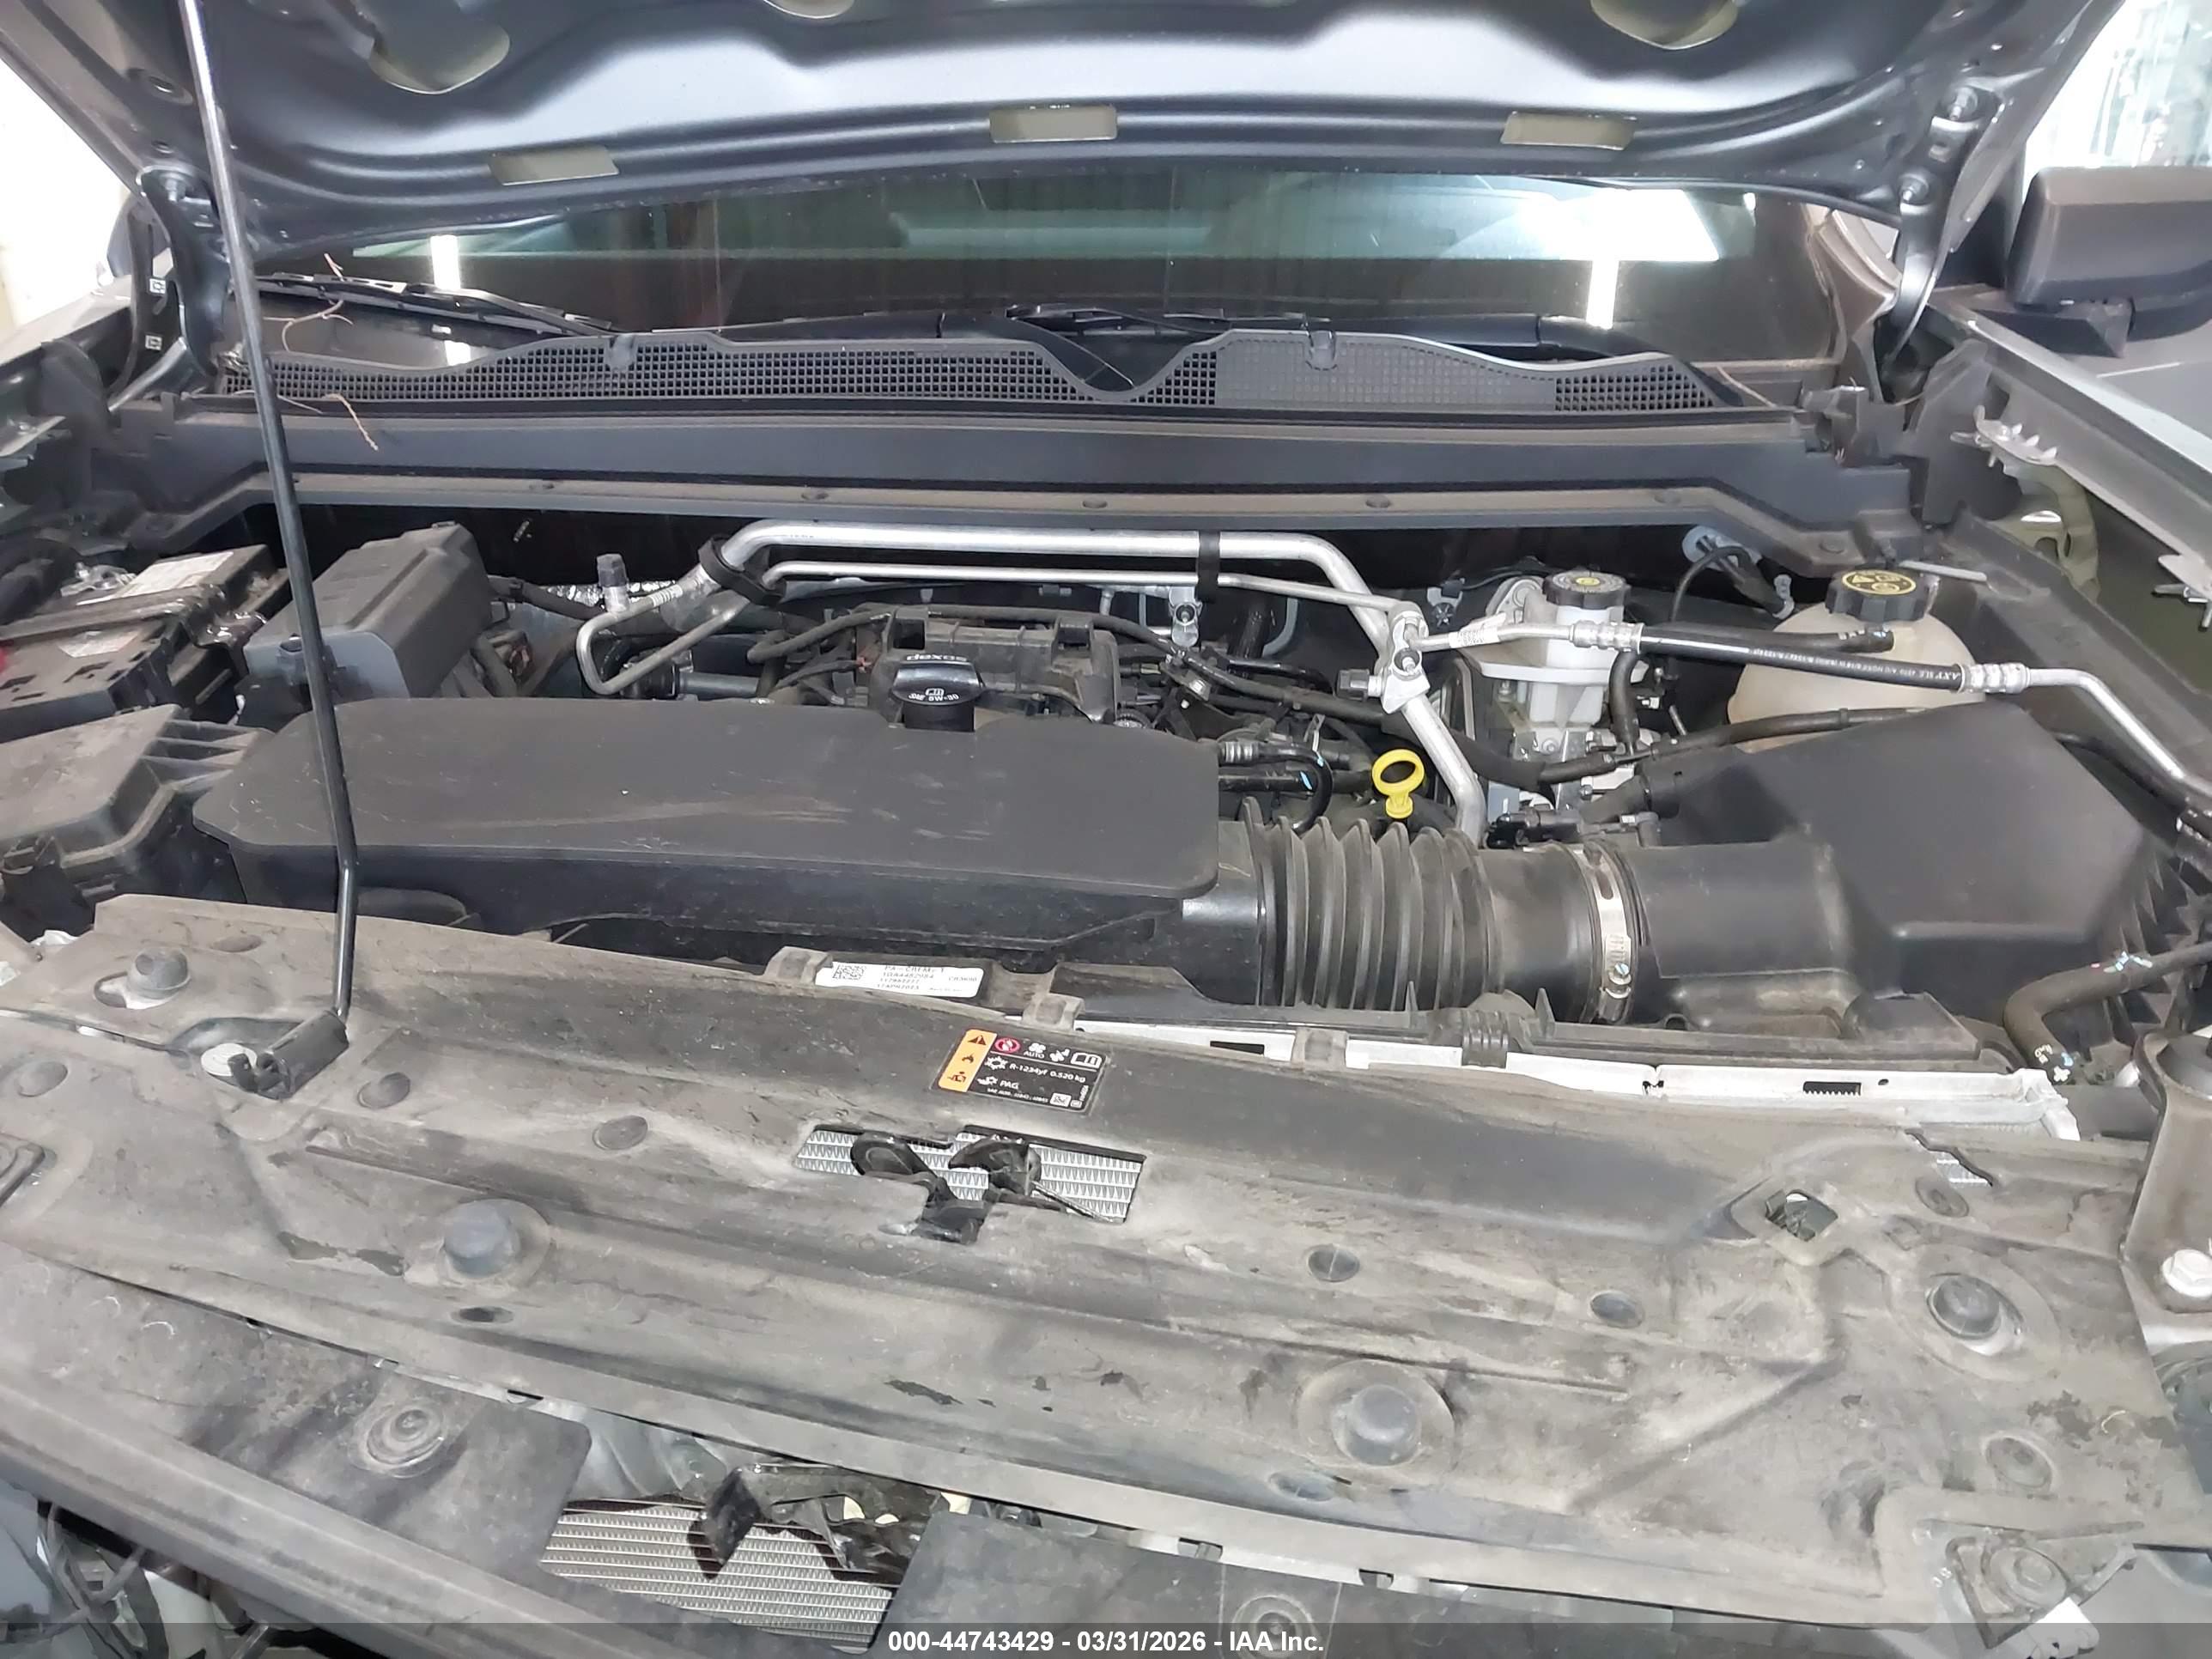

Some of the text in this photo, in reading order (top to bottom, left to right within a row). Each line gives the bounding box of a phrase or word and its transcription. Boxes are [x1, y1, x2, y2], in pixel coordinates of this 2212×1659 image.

[928, 693, 959, 702] 5W-30
[1010, 1064, 1086, 1083] R-1234yf 0.520 kg
[1000, 1080, 1019, 1090] PAG
